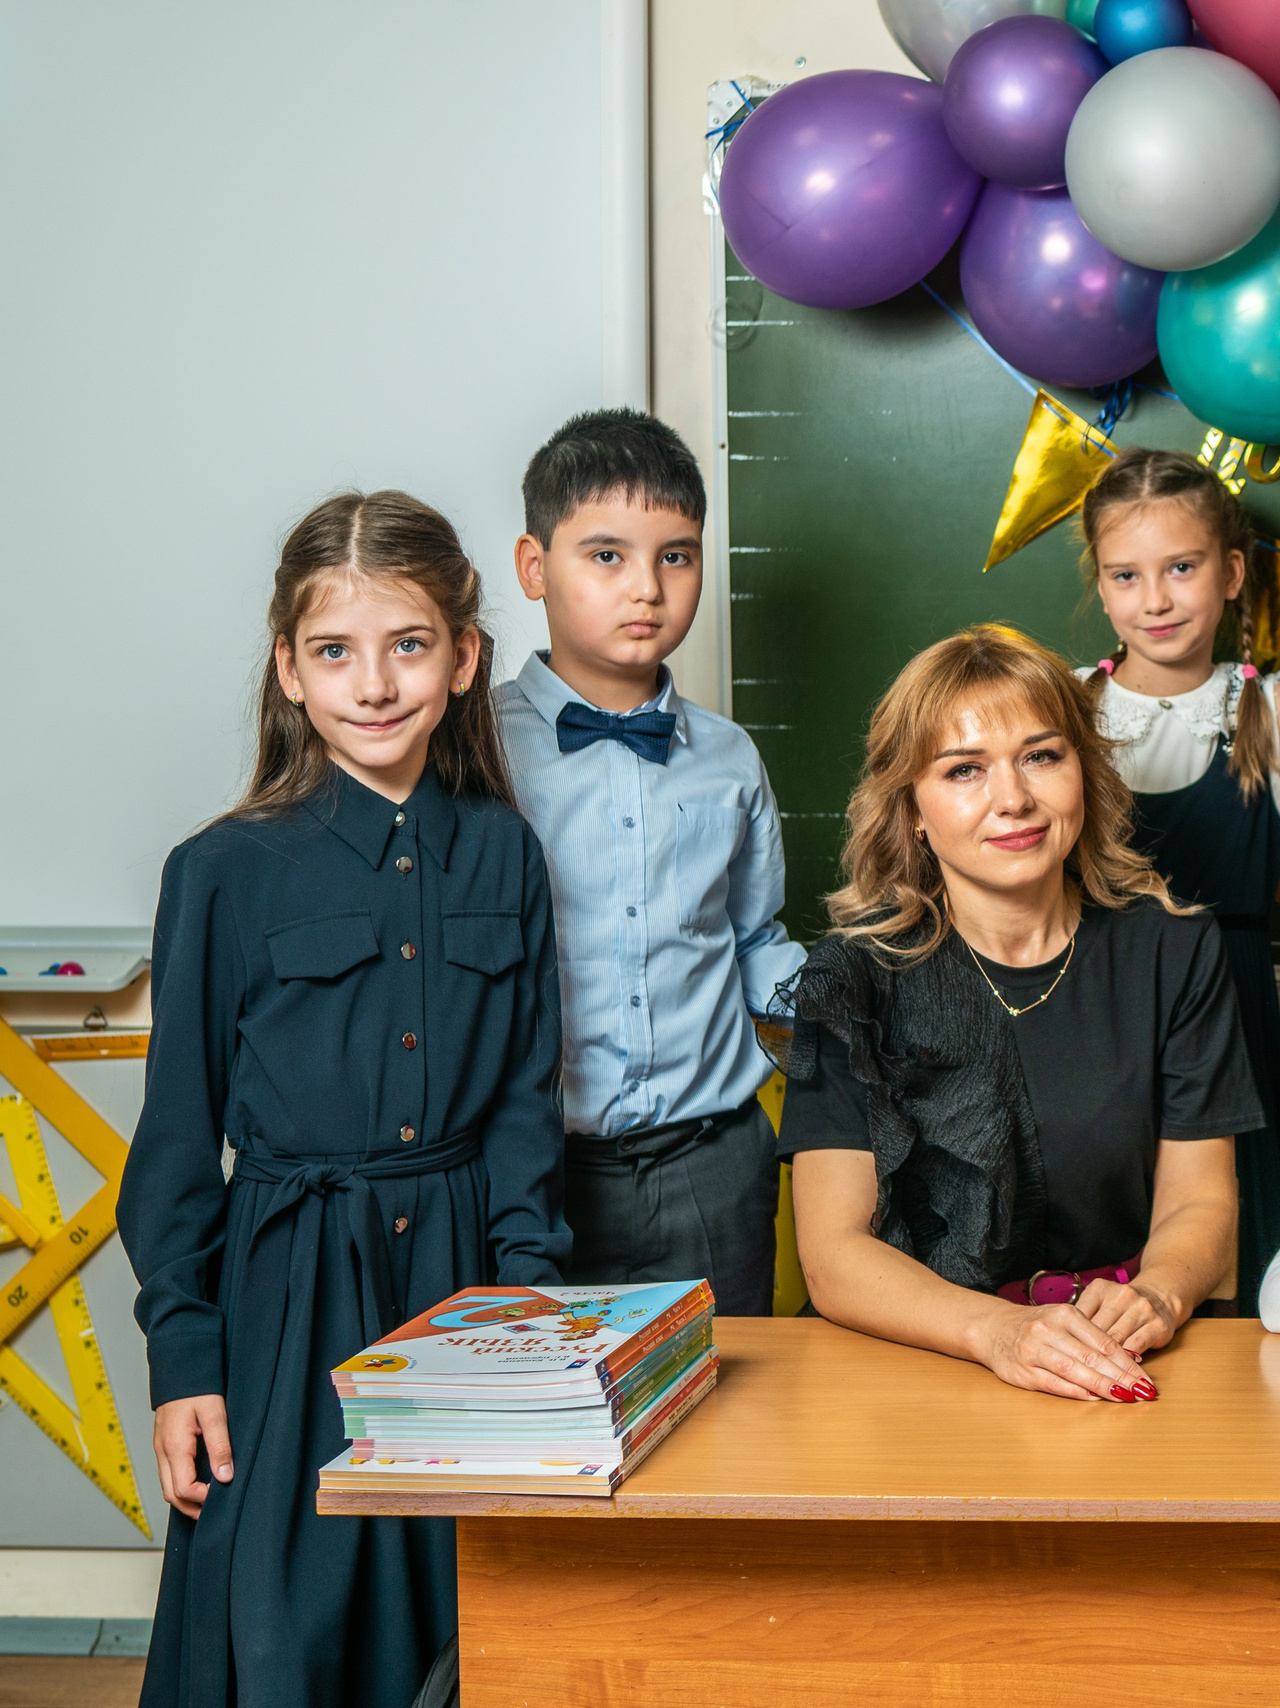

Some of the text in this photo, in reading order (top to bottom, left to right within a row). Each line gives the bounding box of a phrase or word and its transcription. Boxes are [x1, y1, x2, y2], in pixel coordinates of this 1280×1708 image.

[69, 1225, 89, 1246] 10
[7, 1284, 29, 1308] 20
[429, 1296, 539, 1328] 2
[470, 1343, 611, 1355] Русский
